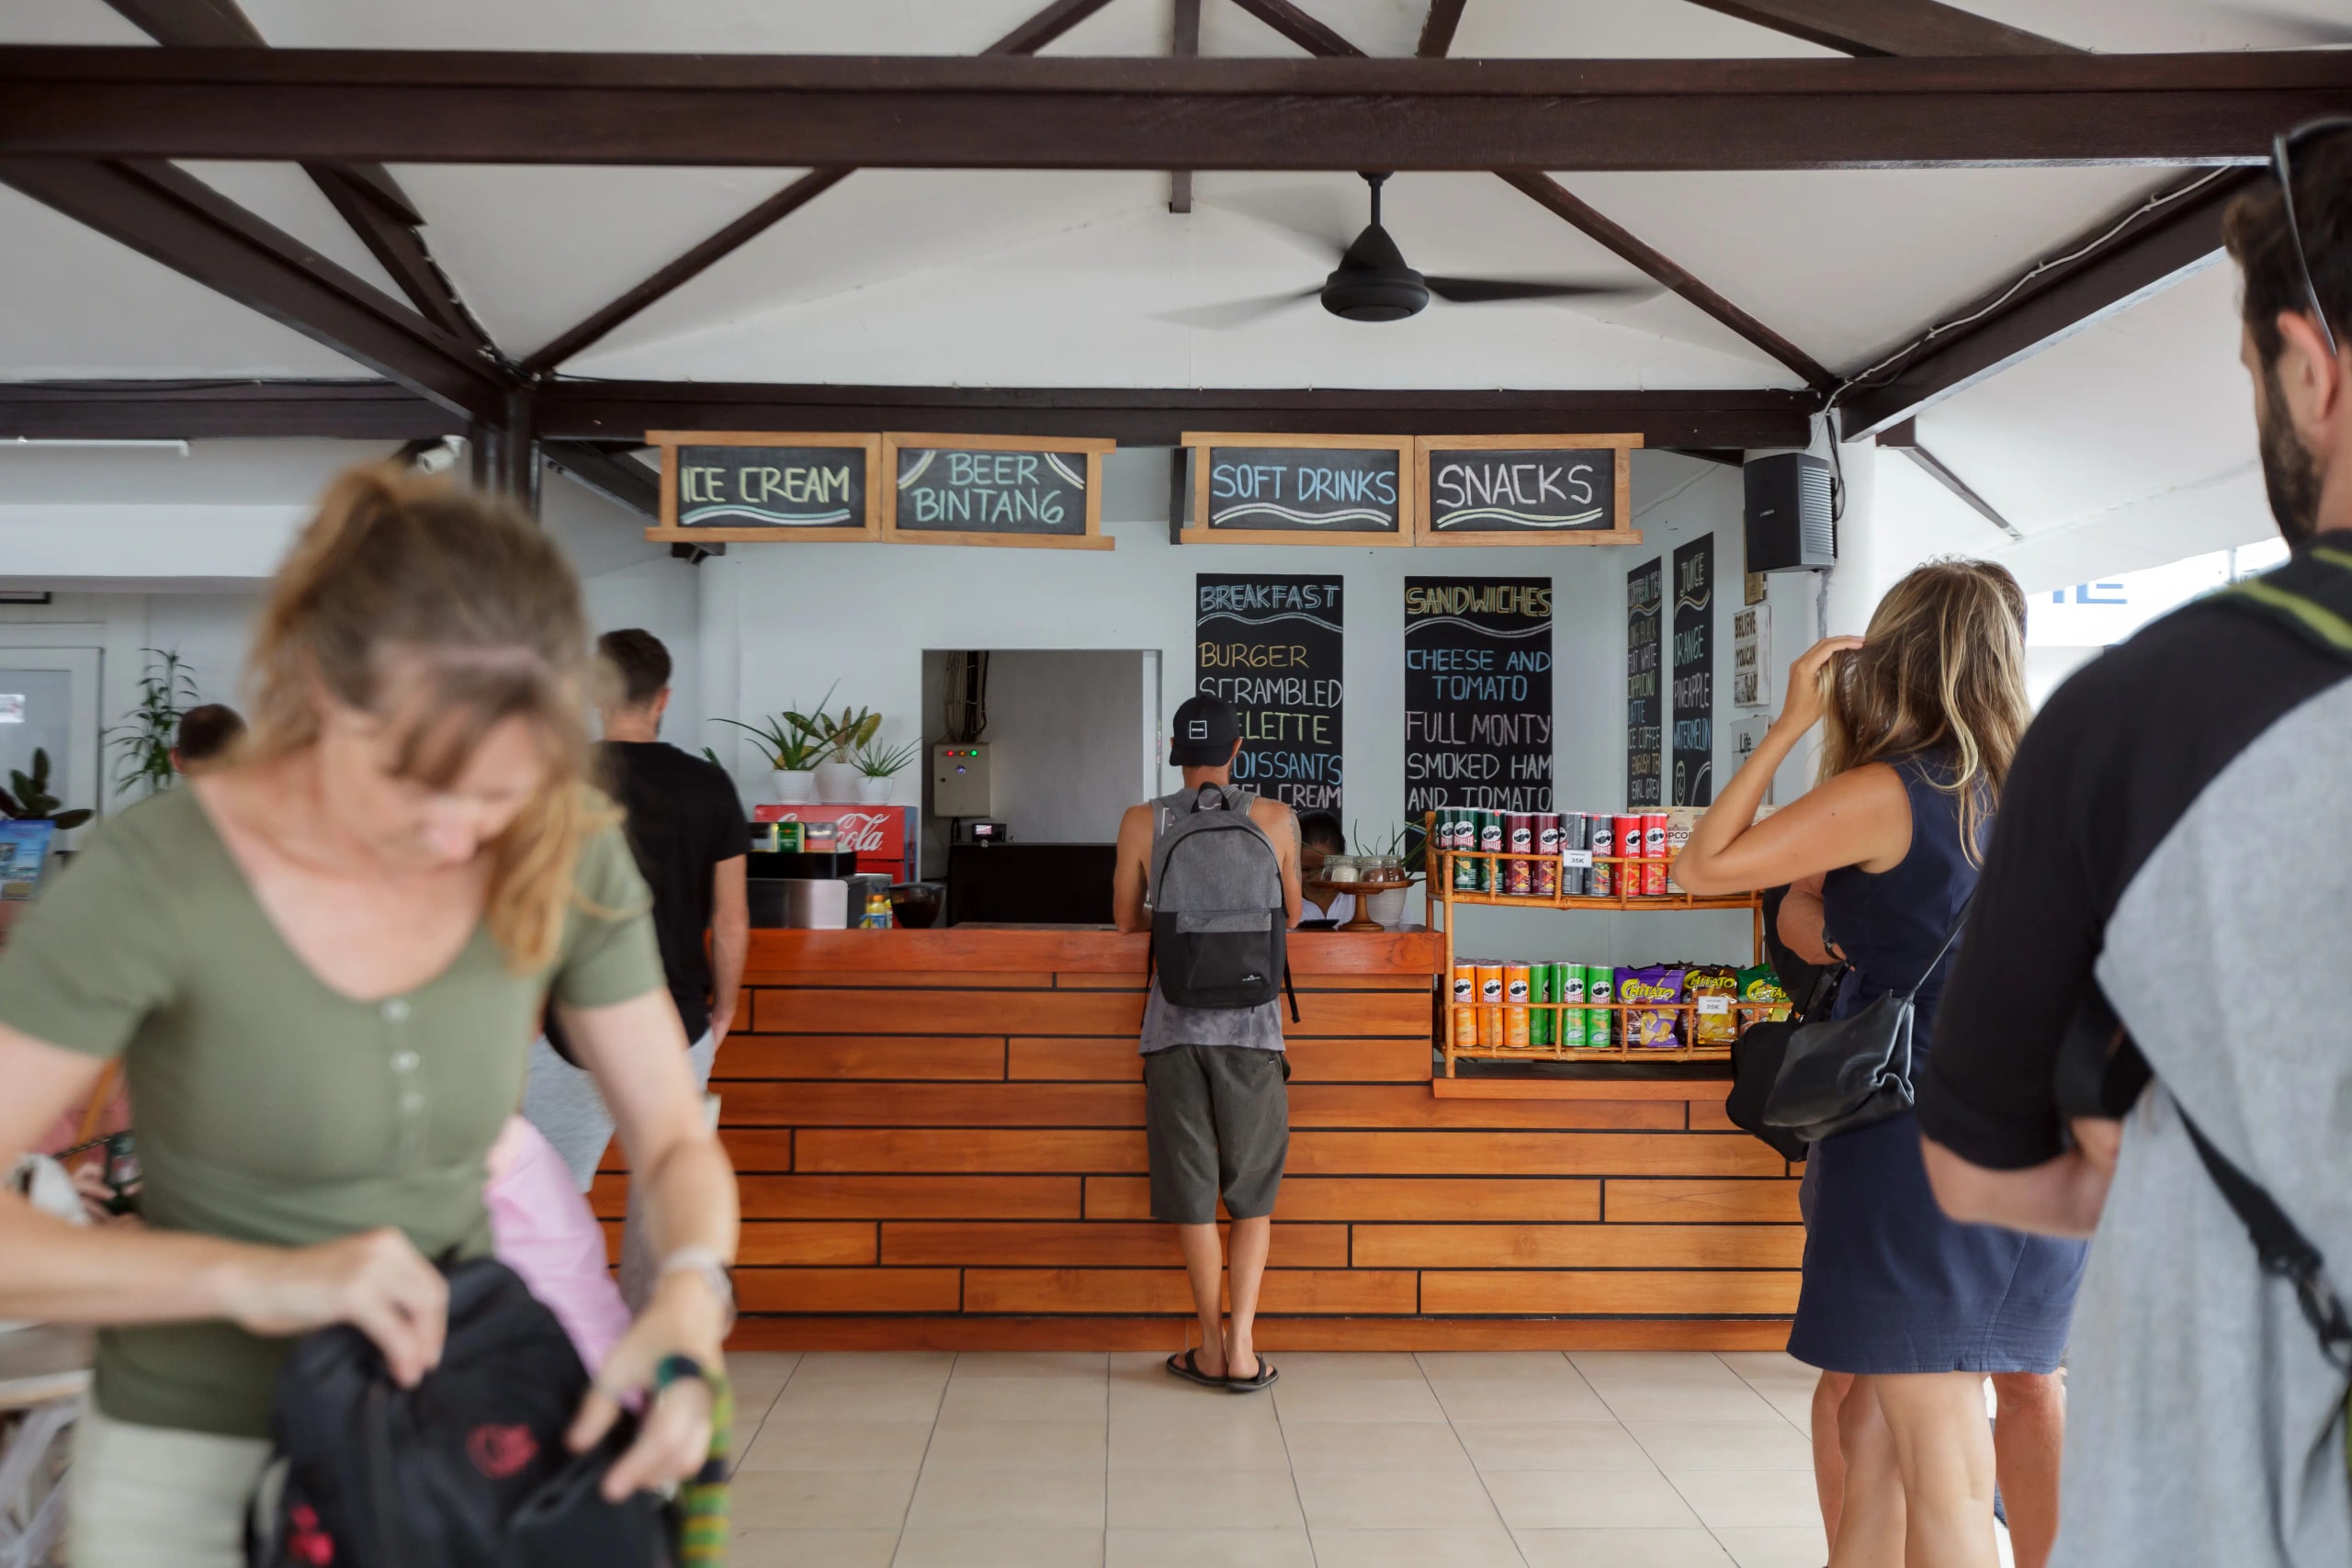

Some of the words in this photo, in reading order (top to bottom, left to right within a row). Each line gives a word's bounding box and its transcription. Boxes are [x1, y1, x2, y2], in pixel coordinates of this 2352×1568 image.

[681, 466, 726, 503] ICE
[739, 466, 850, 503] CREAM
[946, 453, 1039, 486] BEER
[1212, 464, 1287, 500] SOFT
[1297, 467, 1396, 505] DRINKS
[1436, 463, 1594, 508] SNACKS
[911, 488, 1065, 524] BINTANG
[1679, 552, 1704, 597] JUICE
[1200, 583, 1341, 612] BREAKFAST
[1406, 585, 1552, 617] SANDWICHES
[1735, 611, 1756, 639] BELIEVE
[1198, 642, 1310, 669] BURGER
[1407, 649, 1495, 671] CHEESE
[1506, 649, 1552, 672] AND
[1641, 643, 1657, 671] WHITE
[1674, 625, 1704, 668] ORANGE
[1431, 675, 1528, 702] TOMATO
[1674, 671, 1710, 710] PINEAPPLE
[1406, 711, 1466, 745] FULL
[1470, 714, 1551, 747] MONTY
[1674, 717, 1711, 751] WATERMELON
[1739, 732, 1752, 753] Life
[1231, 750, 1343, 785] OISSANTS
[1407, 752, 1500, 780] SMOKED
[1510, 753, 1552, 780] HAM
[1278, 784, 1342, 809] CREAM
[1408, 787, 1449, 812] AND
[1460, 785, 1552, 812] TOMATO
